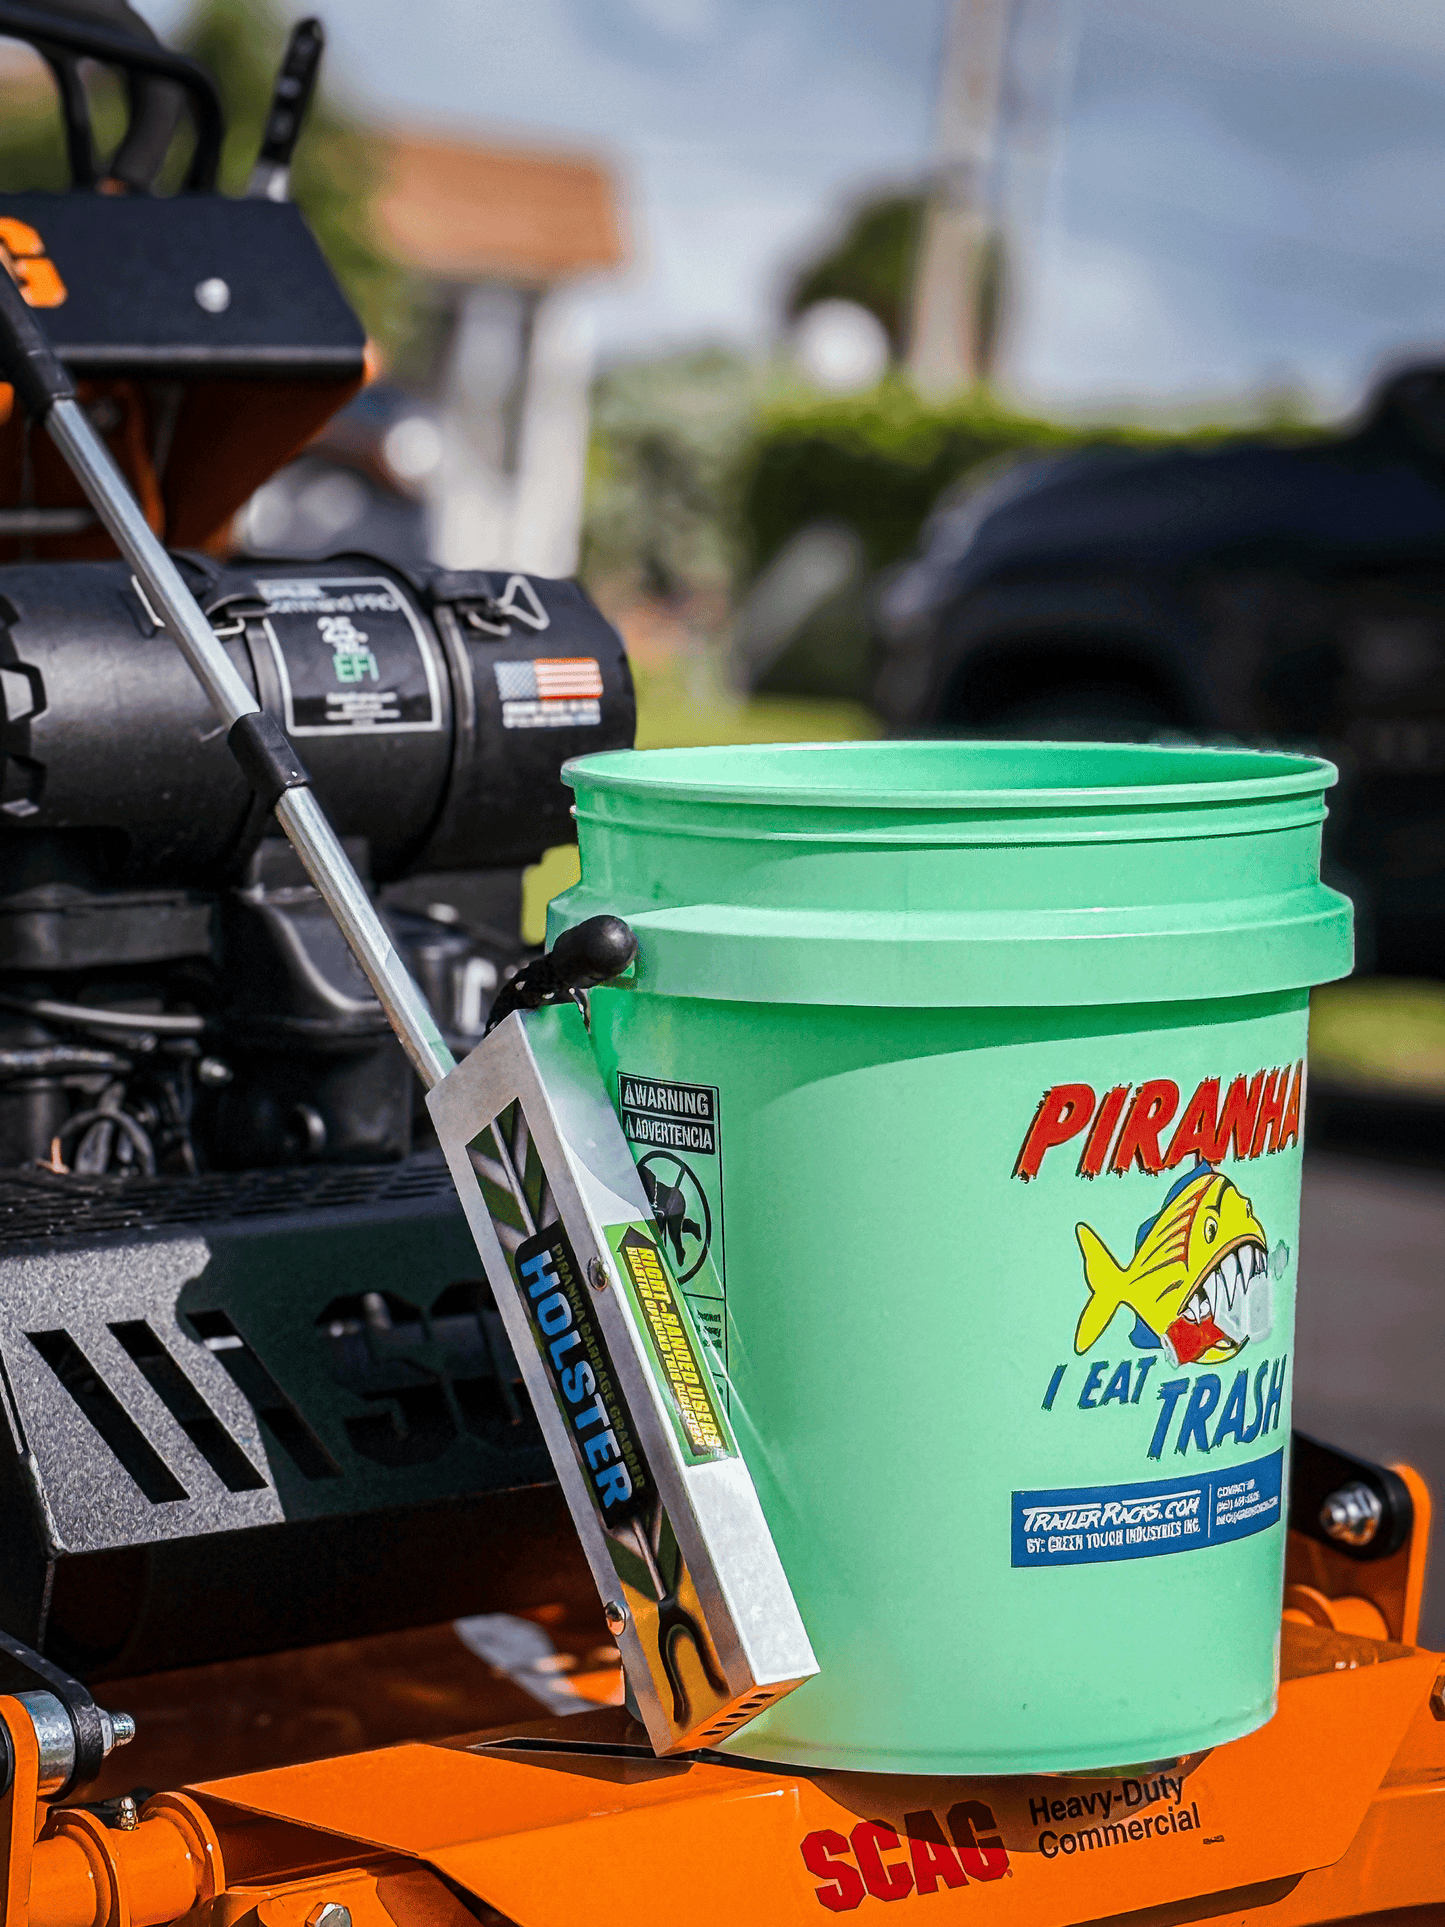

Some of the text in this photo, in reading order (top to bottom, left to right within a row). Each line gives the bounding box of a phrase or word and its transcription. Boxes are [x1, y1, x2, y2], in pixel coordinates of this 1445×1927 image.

[634, 1083, 709, 1116] WARNING
[1011, 1059, 1303, 1183] PIRANHA
[636, 1117, 713, 1150] ADVERTENCIA
[520, 1250, 632, 1509] HOLSTER
[552, 1243, 646, 1489] PIRANHA GARBAGE GRABBER
[1041, 1355, 1158, 1411] I EAT
[686, 1385, 722, 1448] USERS
[1146, 1354, 1287, 1461] TRASH
[1026, 1537, 1046, 1553] BY:
[1047, 1533, 1084, 1553] GREEN
[1085, 1529, 1124, 1549] TOUCH
[1125, 1521, 1182, 1545] INDUSTRIES
[1028, 1774, 1185, 1826] Heavy-Duty
[800, 1800, 1010, 1912] SCAG
[1037, 1802, 1201, 1859] Commercial
